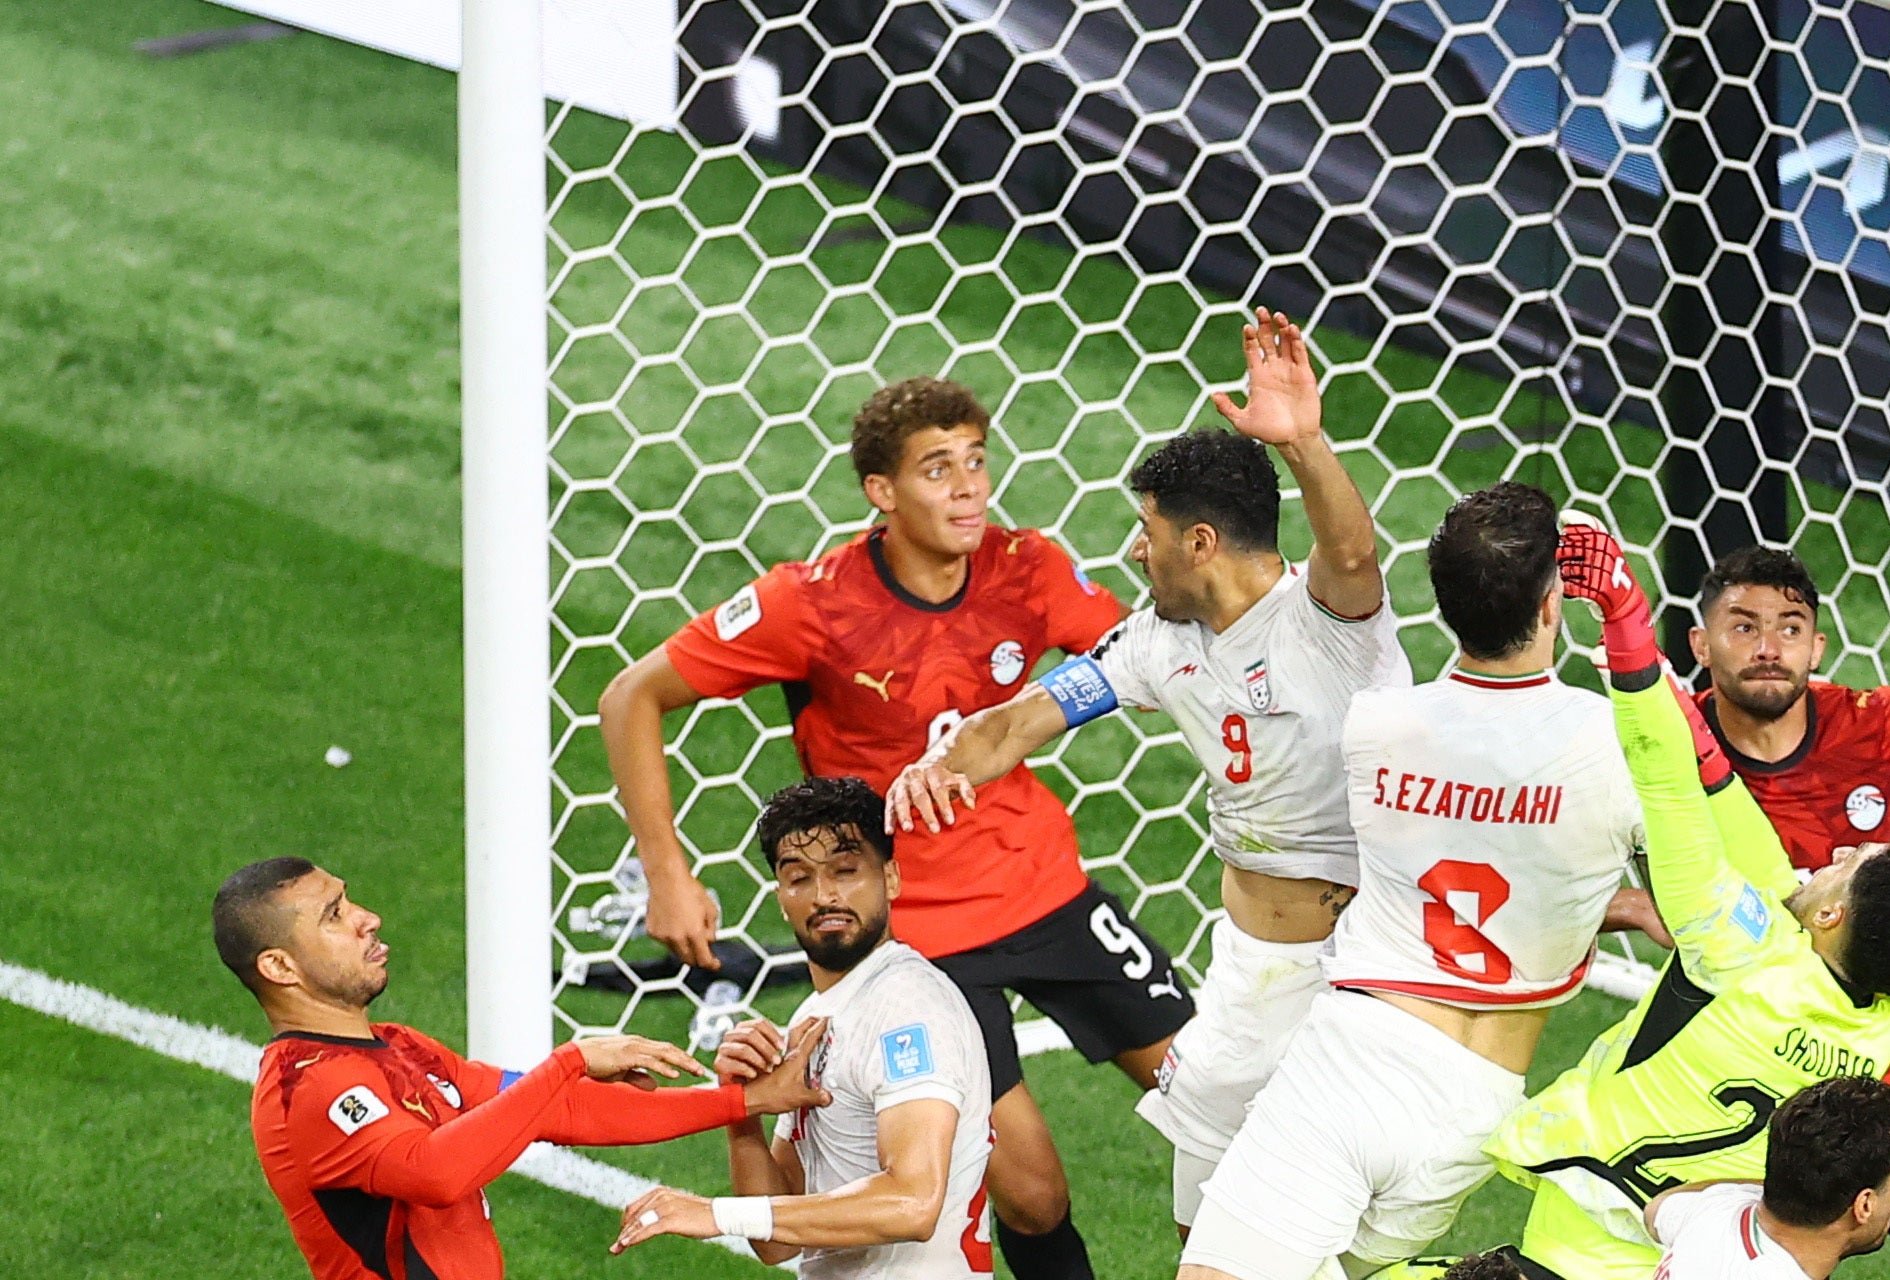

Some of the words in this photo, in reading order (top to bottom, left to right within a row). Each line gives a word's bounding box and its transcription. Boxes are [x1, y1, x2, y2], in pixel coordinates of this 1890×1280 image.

[1221, 714, 1252, 785] 9
[1373, 767, 1564, 825] S.EZATOLAHI
[1090, 902, 1153, 981] 9
[1417, 858, 1512, 985] 8
